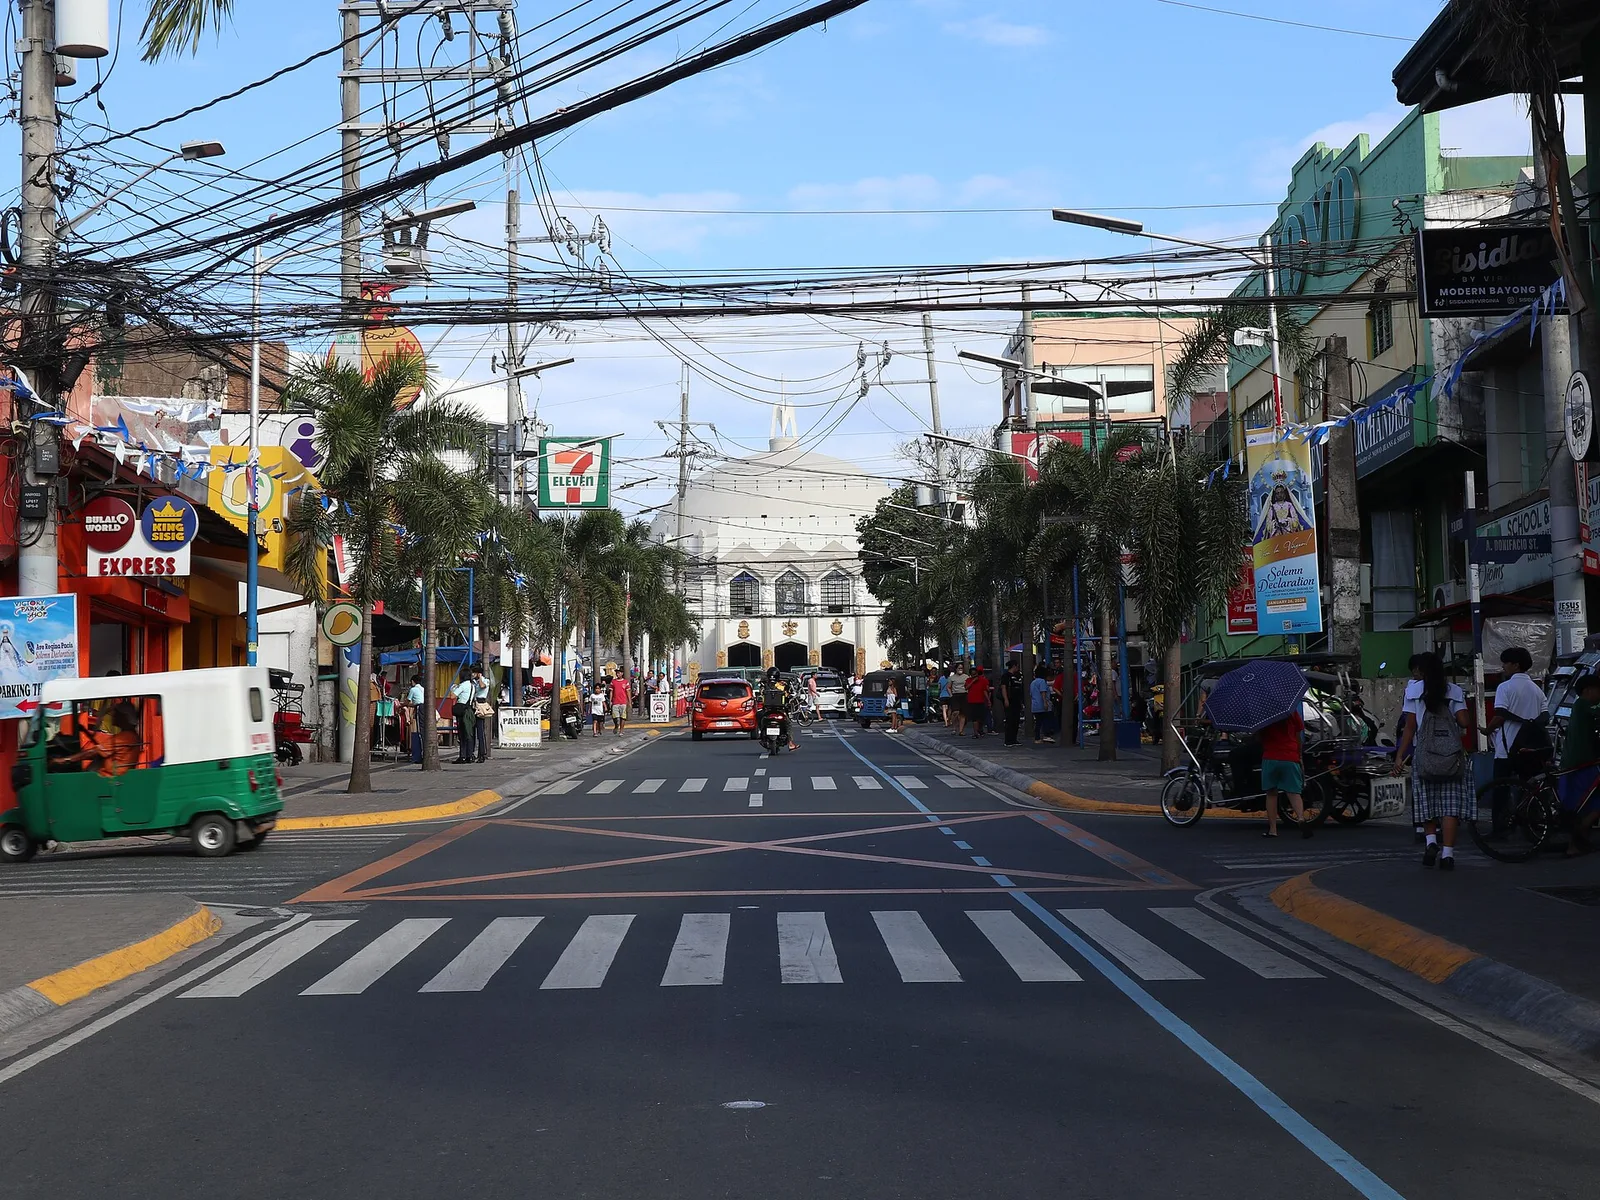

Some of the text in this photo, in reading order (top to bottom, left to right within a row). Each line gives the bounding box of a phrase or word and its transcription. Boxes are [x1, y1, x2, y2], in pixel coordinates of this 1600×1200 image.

[1439, 286, 1487, 297] MODERN
[1489, 285, 1536, 296] BAYONG
[555, 451, 593, 504] 7
[85, 513, 129, 524] BULALO
[1507, 504, 1550, 537] SCHOOL &
[85, 524, 122, 532] WORLD
[152, 523, 184, 532] KING
[151, 532, 185, 541] SISIG
[1485, 538, 1539, 551] A. BONIFACIO ST.
[99, 557, 176, 575] EXPRESS
[1267, 566, 1303, 582] Solemn
[1257, 577, 1315, 592] Declaration
[45, 643, 60, 652] Regina
